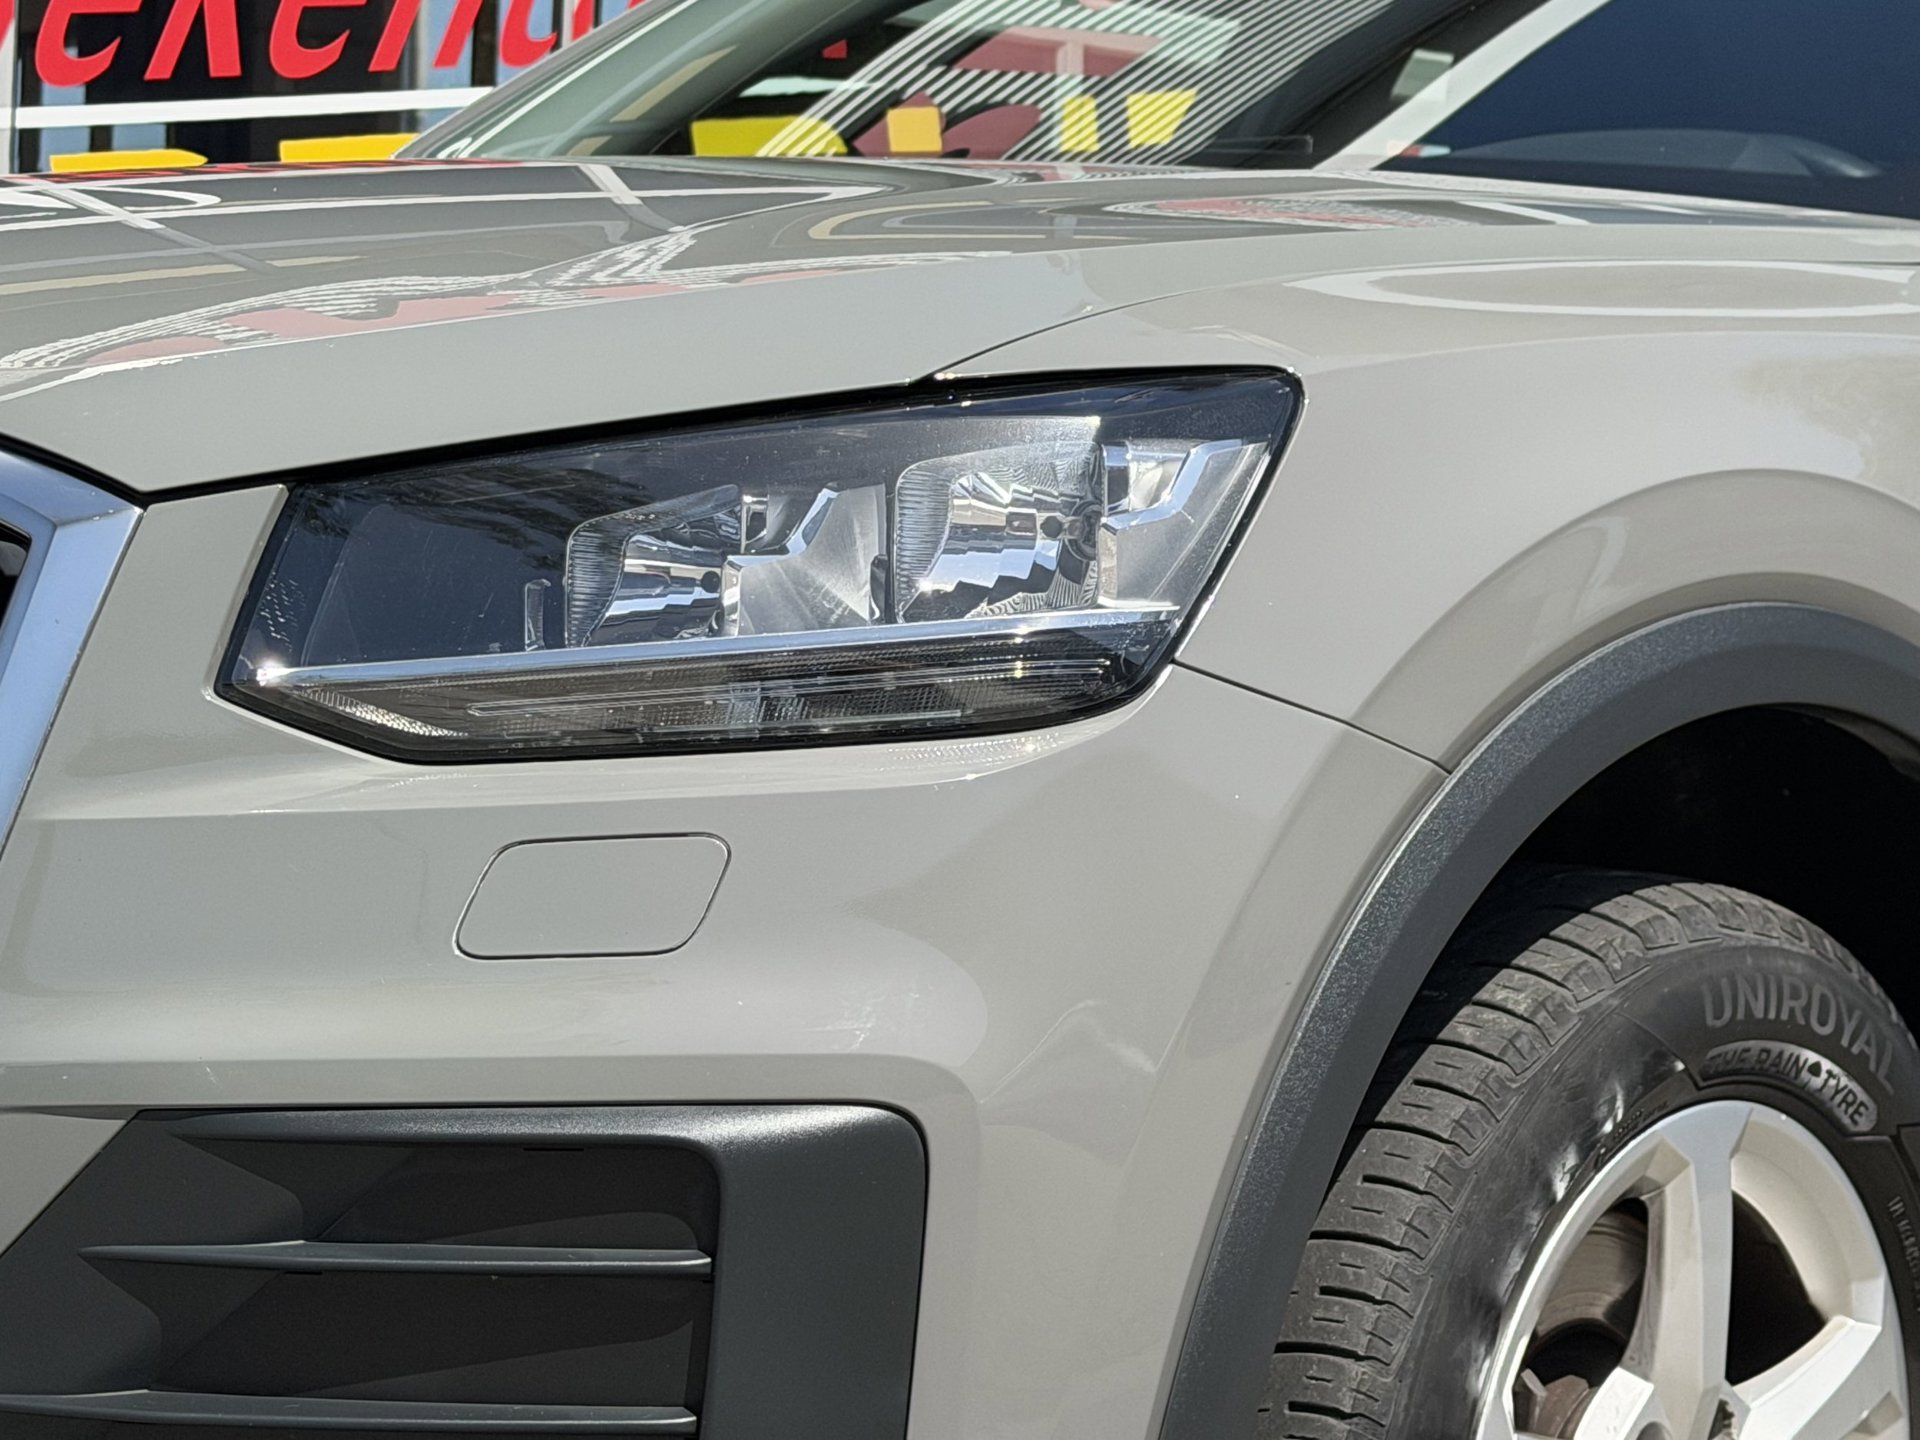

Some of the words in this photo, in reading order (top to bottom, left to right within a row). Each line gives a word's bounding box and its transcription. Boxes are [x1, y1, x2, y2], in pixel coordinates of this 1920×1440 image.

[1702, 972, 1895, 1095] UNIROYAL
[1706, 1048, 1753, 1075] THE
[1755, 1047, 1809, 1082] RAIN
[1817, 1068, 1870, 1127] TYRE
